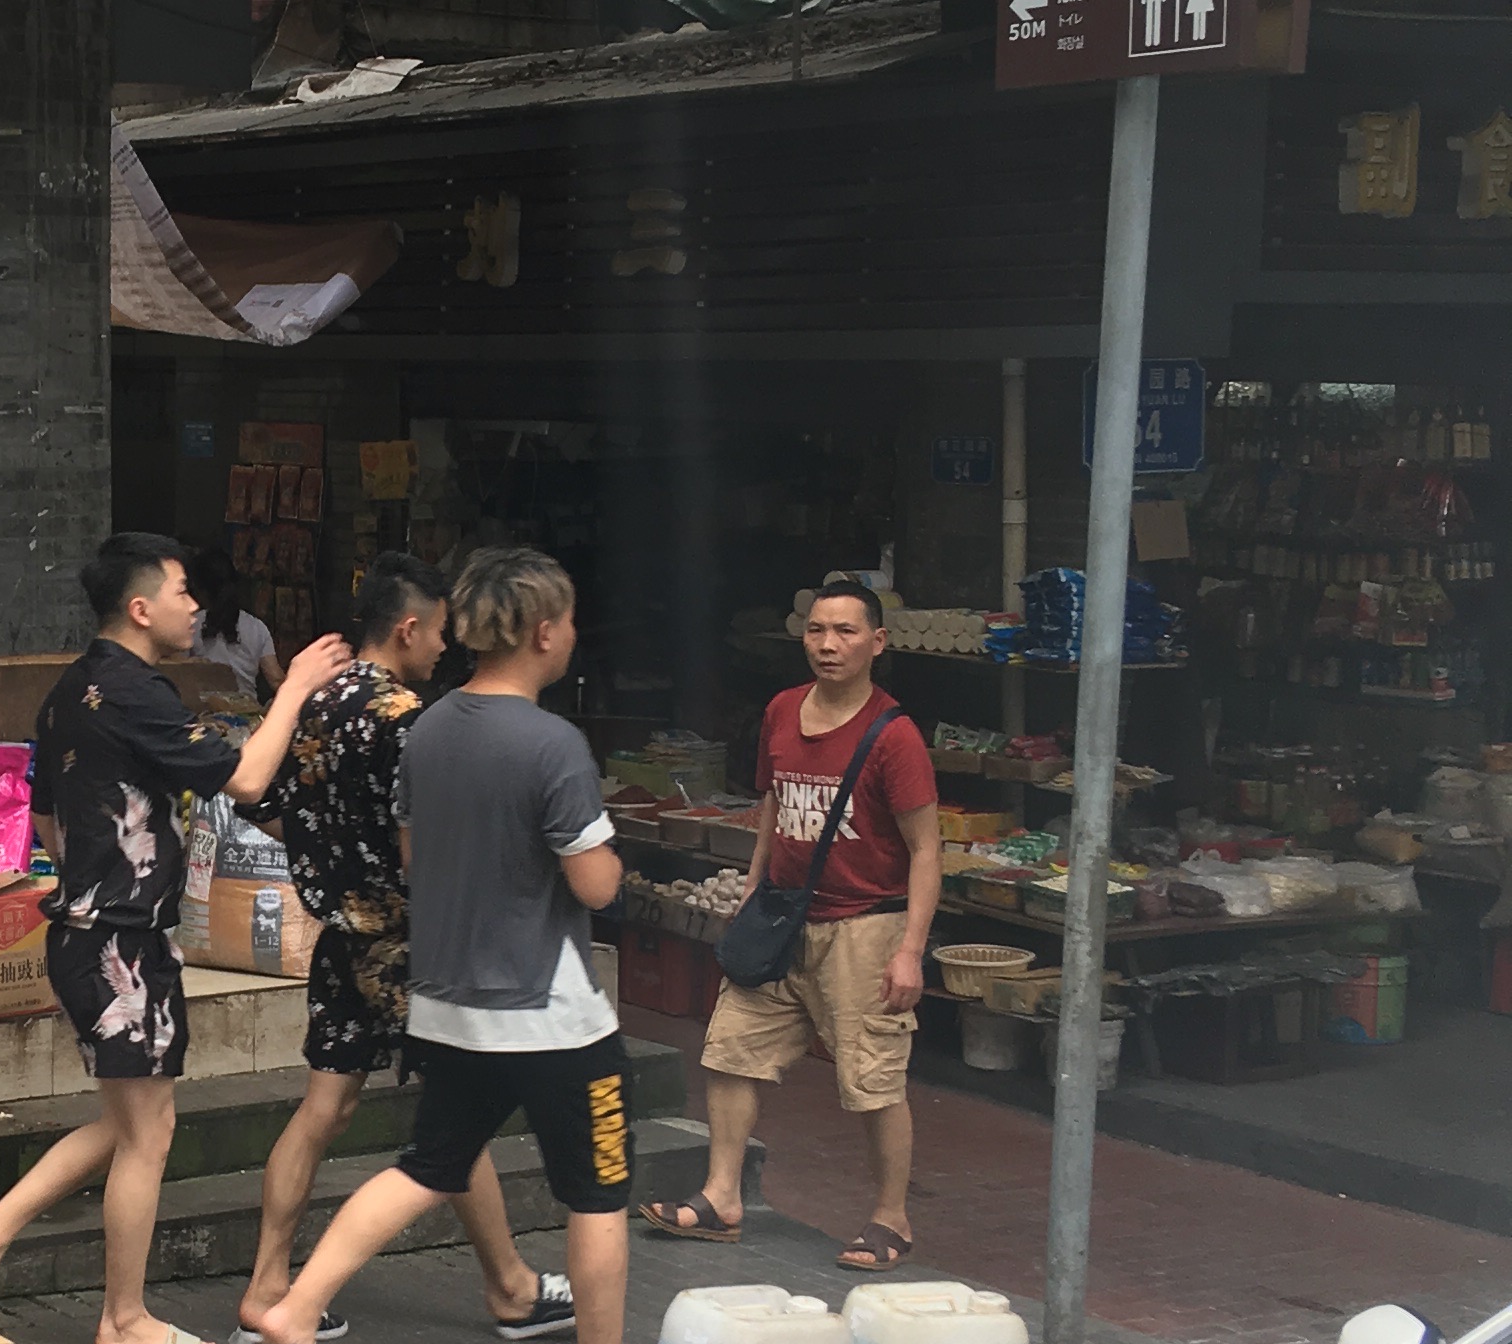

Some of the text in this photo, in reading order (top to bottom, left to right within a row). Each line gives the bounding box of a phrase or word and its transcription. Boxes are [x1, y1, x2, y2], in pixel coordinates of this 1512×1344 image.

[1008, 20, 1046, 41] 50M
[223, 847, 289, 867] 全犬通用
